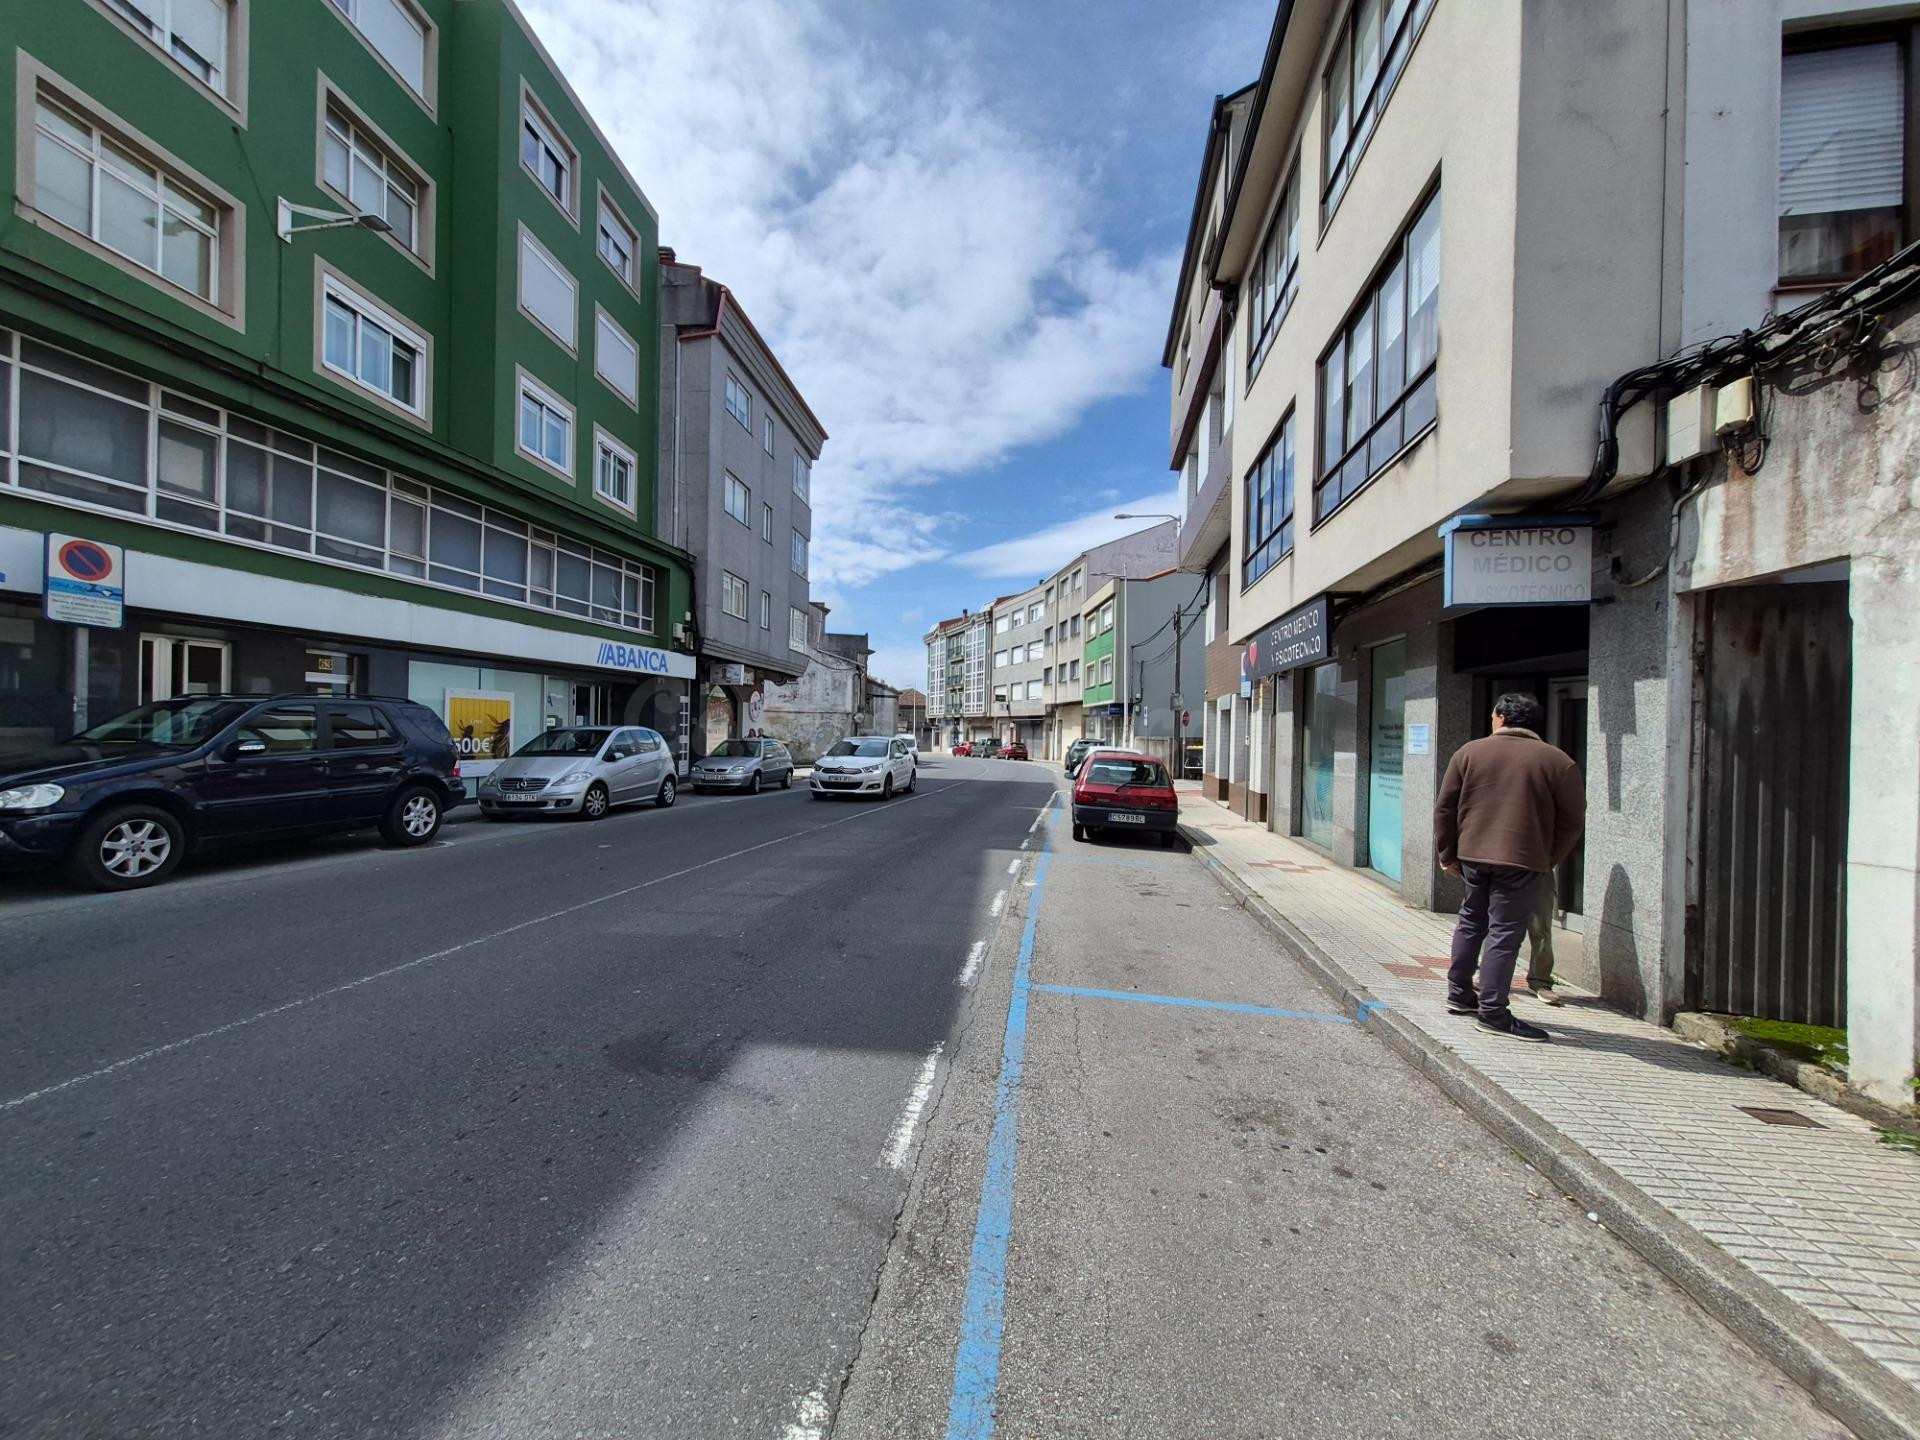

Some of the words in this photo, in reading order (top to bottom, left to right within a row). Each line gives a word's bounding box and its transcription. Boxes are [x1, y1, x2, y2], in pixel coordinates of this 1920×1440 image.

[1471, 528, 1575, 547] CENTRO
[1472, 553, 1573, 573] MÉDICO
[1476, 581, 1585, 601] PSICOTÉCNICO
[1271, 622, 1292, 646] CENTRO
